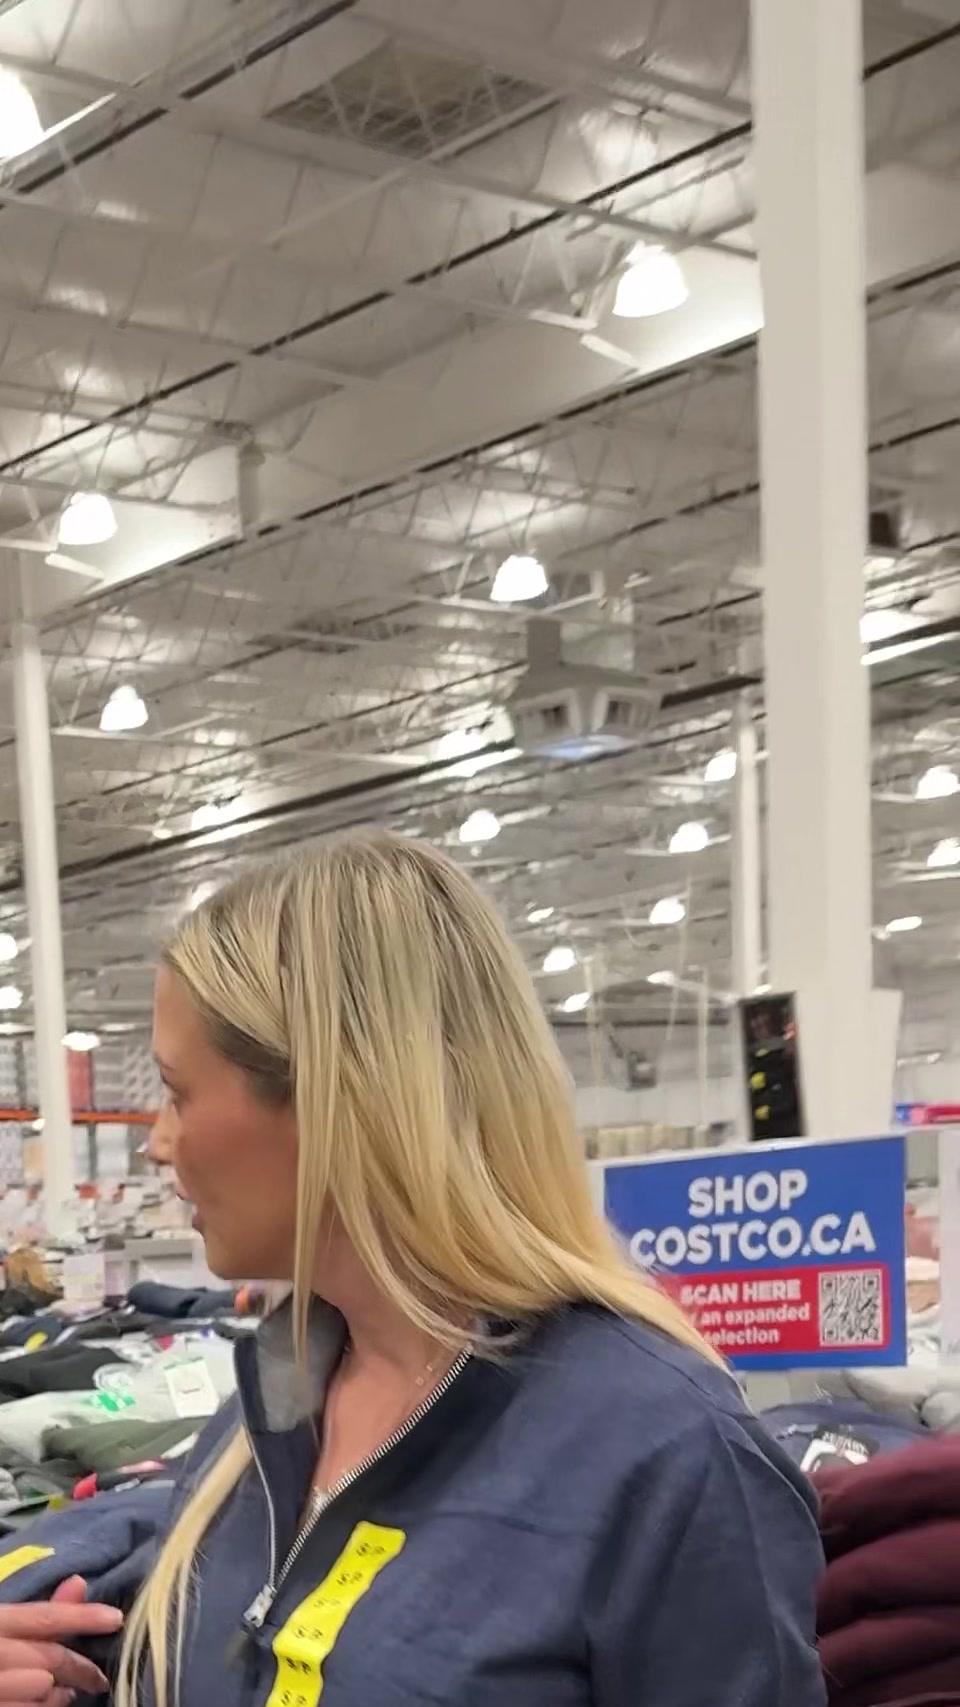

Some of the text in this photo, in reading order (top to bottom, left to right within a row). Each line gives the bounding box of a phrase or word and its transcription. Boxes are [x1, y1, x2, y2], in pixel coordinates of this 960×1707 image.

[688, 1168, 808, 1218] SHOP
[630, 1211, 876, 1266] COSTCO.CA
[742, 1279, 801, 1303] HERE
[725, 1302, 810, 1327] expanded
